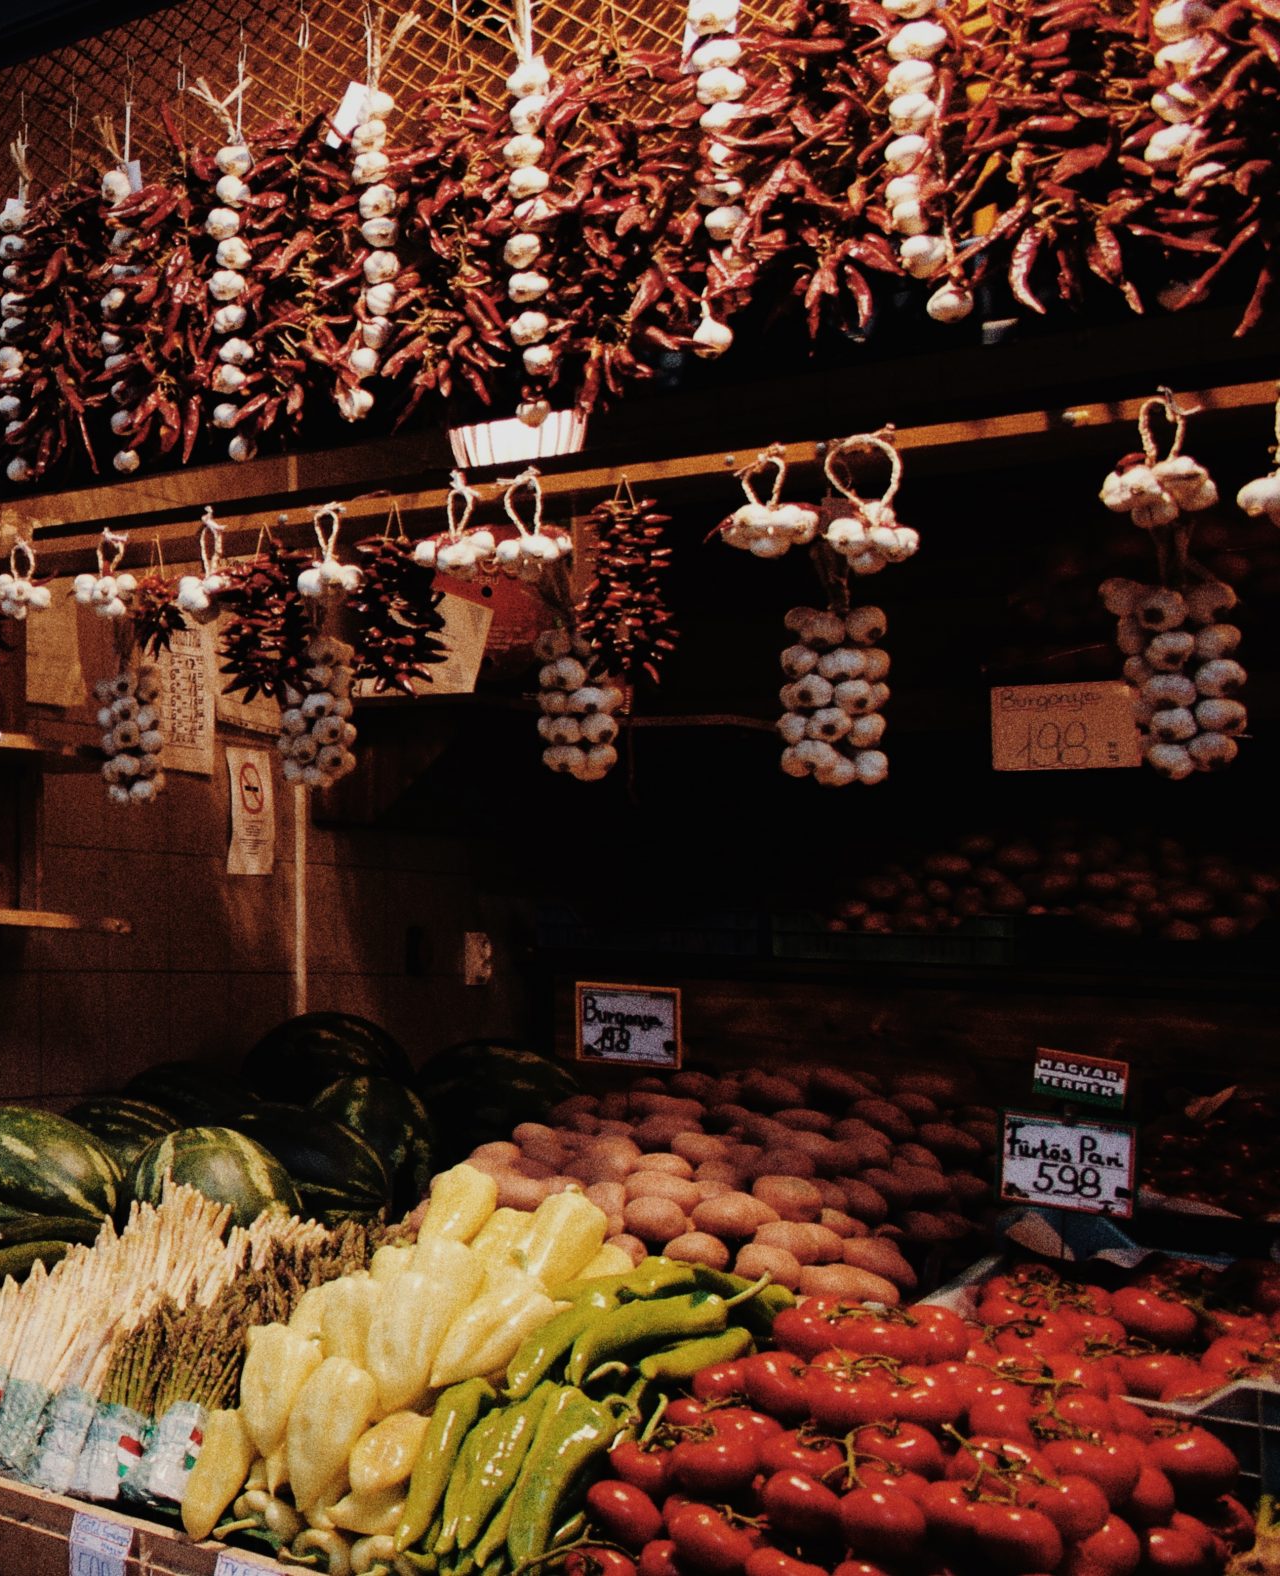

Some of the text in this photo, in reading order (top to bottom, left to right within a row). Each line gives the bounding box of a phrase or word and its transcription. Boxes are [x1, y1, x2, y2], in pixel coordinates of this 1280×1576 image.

[1016, 721, 1090, 768] 198
[1039, 1058, 1120, 1082] MAGYAR
[1079, 1136, 1124, 1168] Pari
[1033, 1162, 1102, 1198] 598
